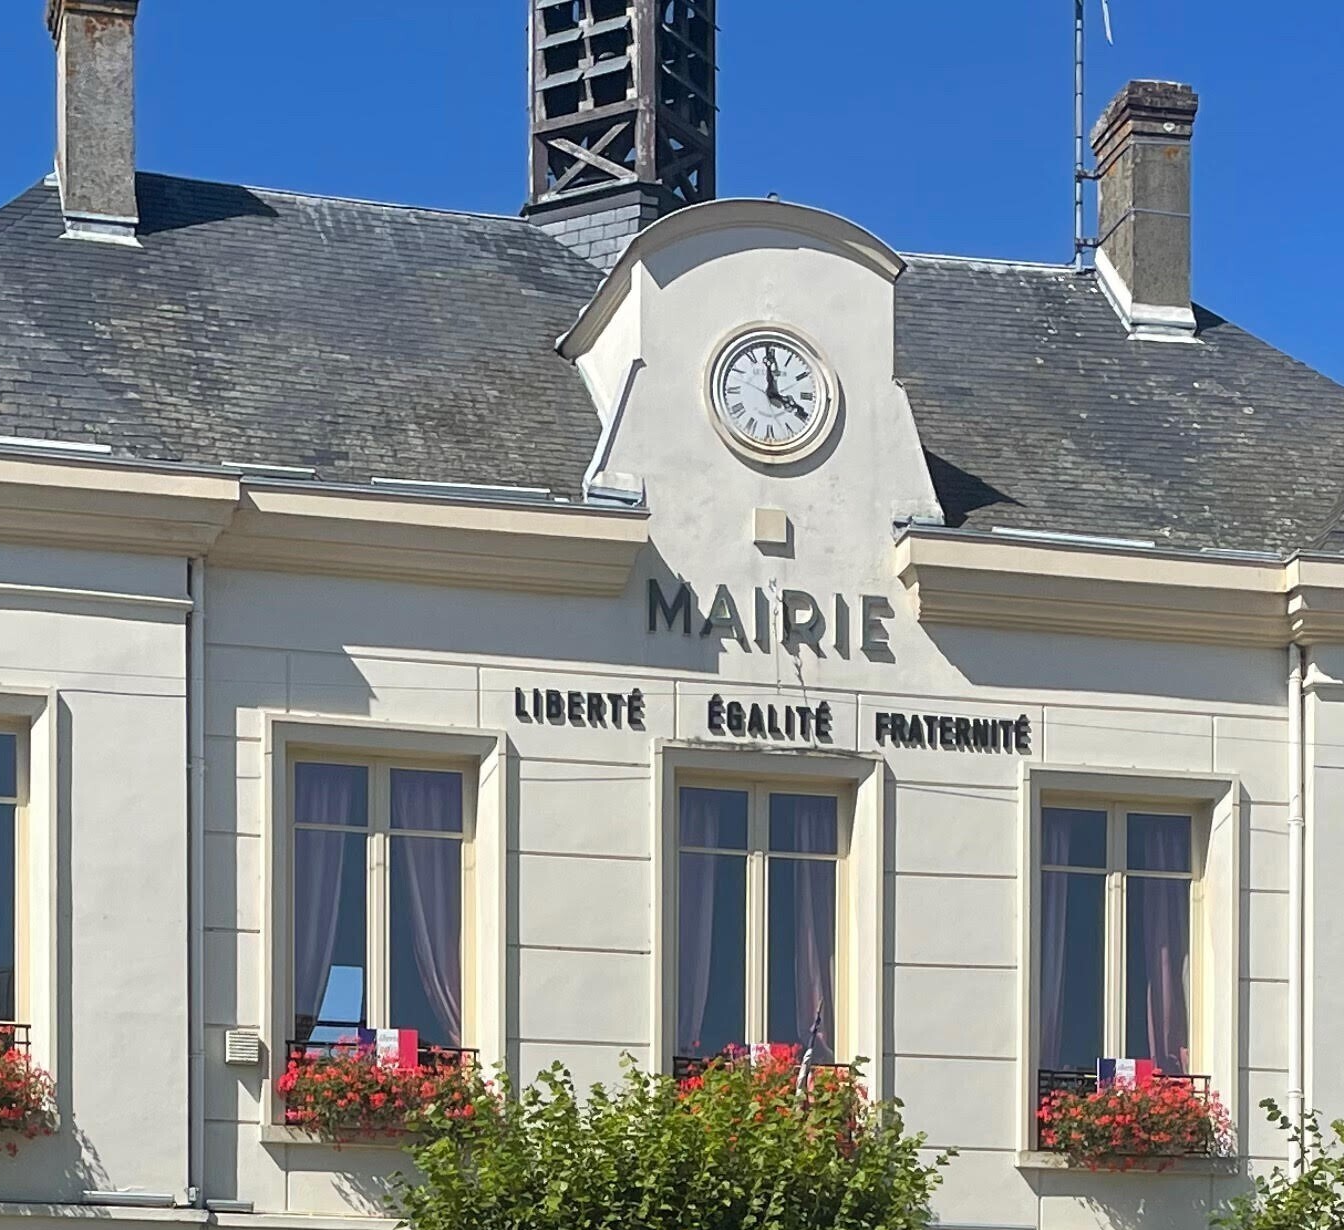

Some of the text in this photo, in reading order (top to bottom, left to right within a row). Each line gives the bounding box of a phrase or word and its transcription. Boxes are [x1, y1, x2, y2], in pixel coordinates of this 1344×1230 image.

[647, 578, 895, 660] MAIRIE
[515, 686, 1032, 754] LIBERTÉ ÉGALITÉ FRATERNITÉ
